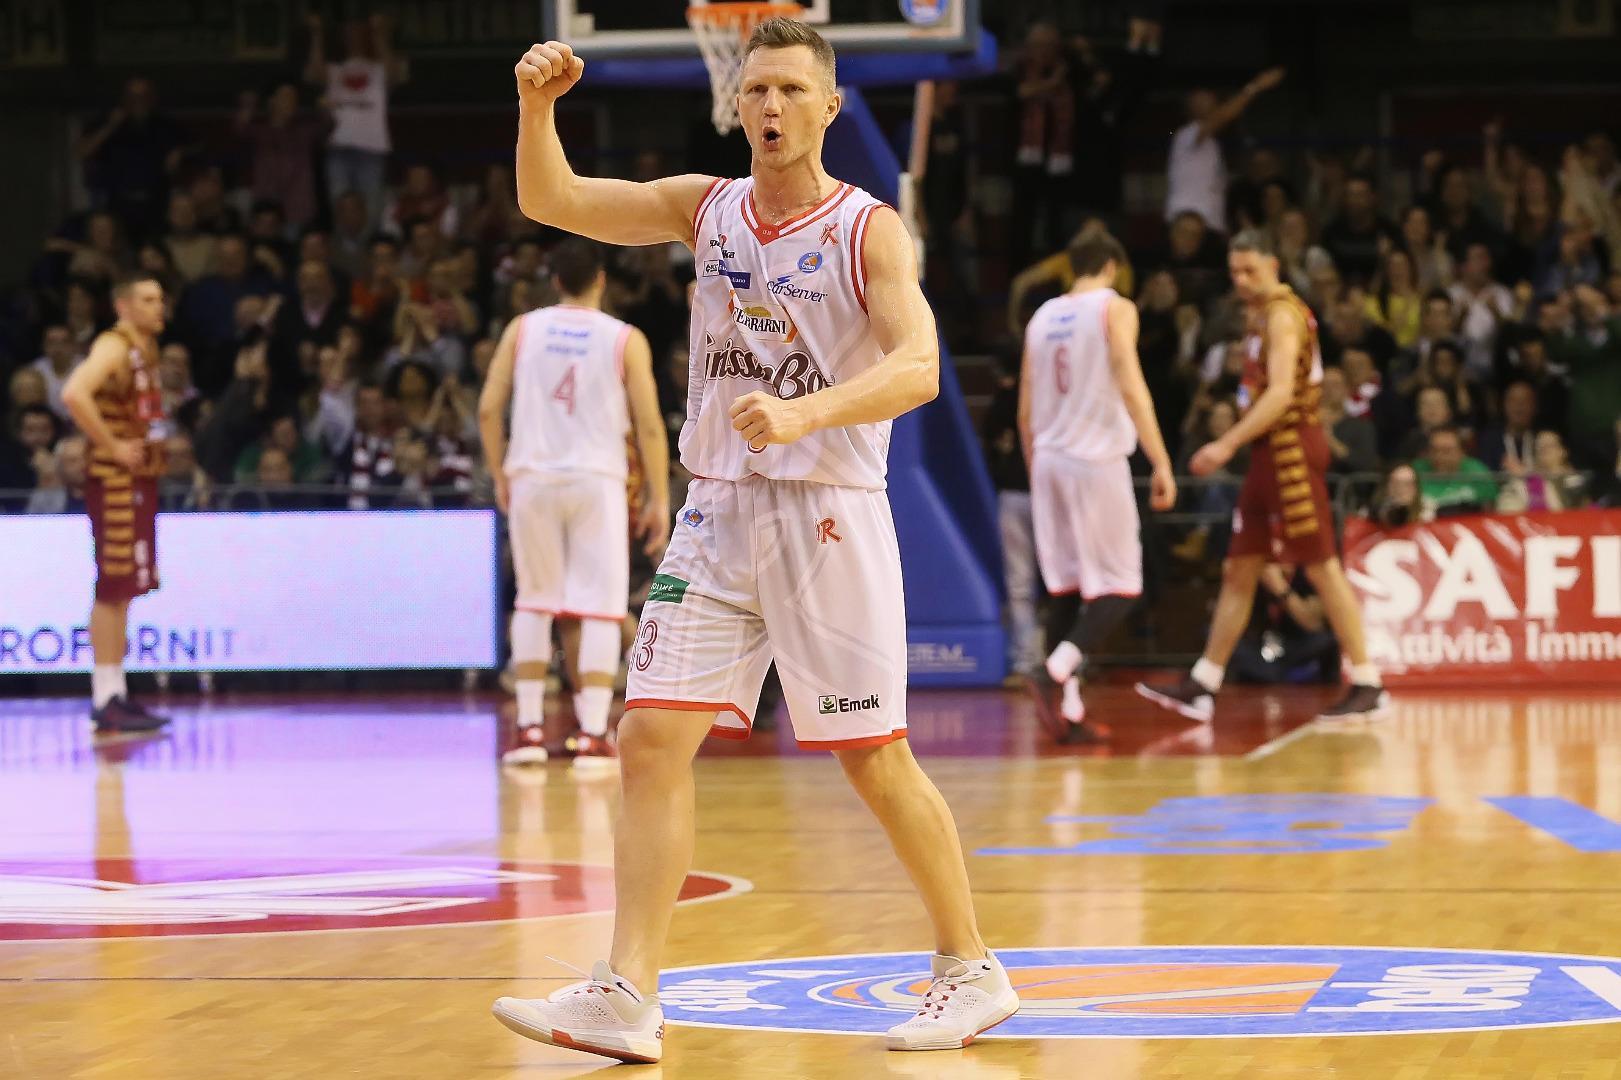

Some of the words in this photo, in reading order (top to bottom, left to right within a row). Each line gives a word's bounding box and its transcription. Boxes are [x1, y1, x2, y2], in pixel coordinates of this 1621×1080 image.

[552, 364, 577, 415] 4
[1054, 344, 1072, 396] 6
[838, 694, 880, 713] Emak
